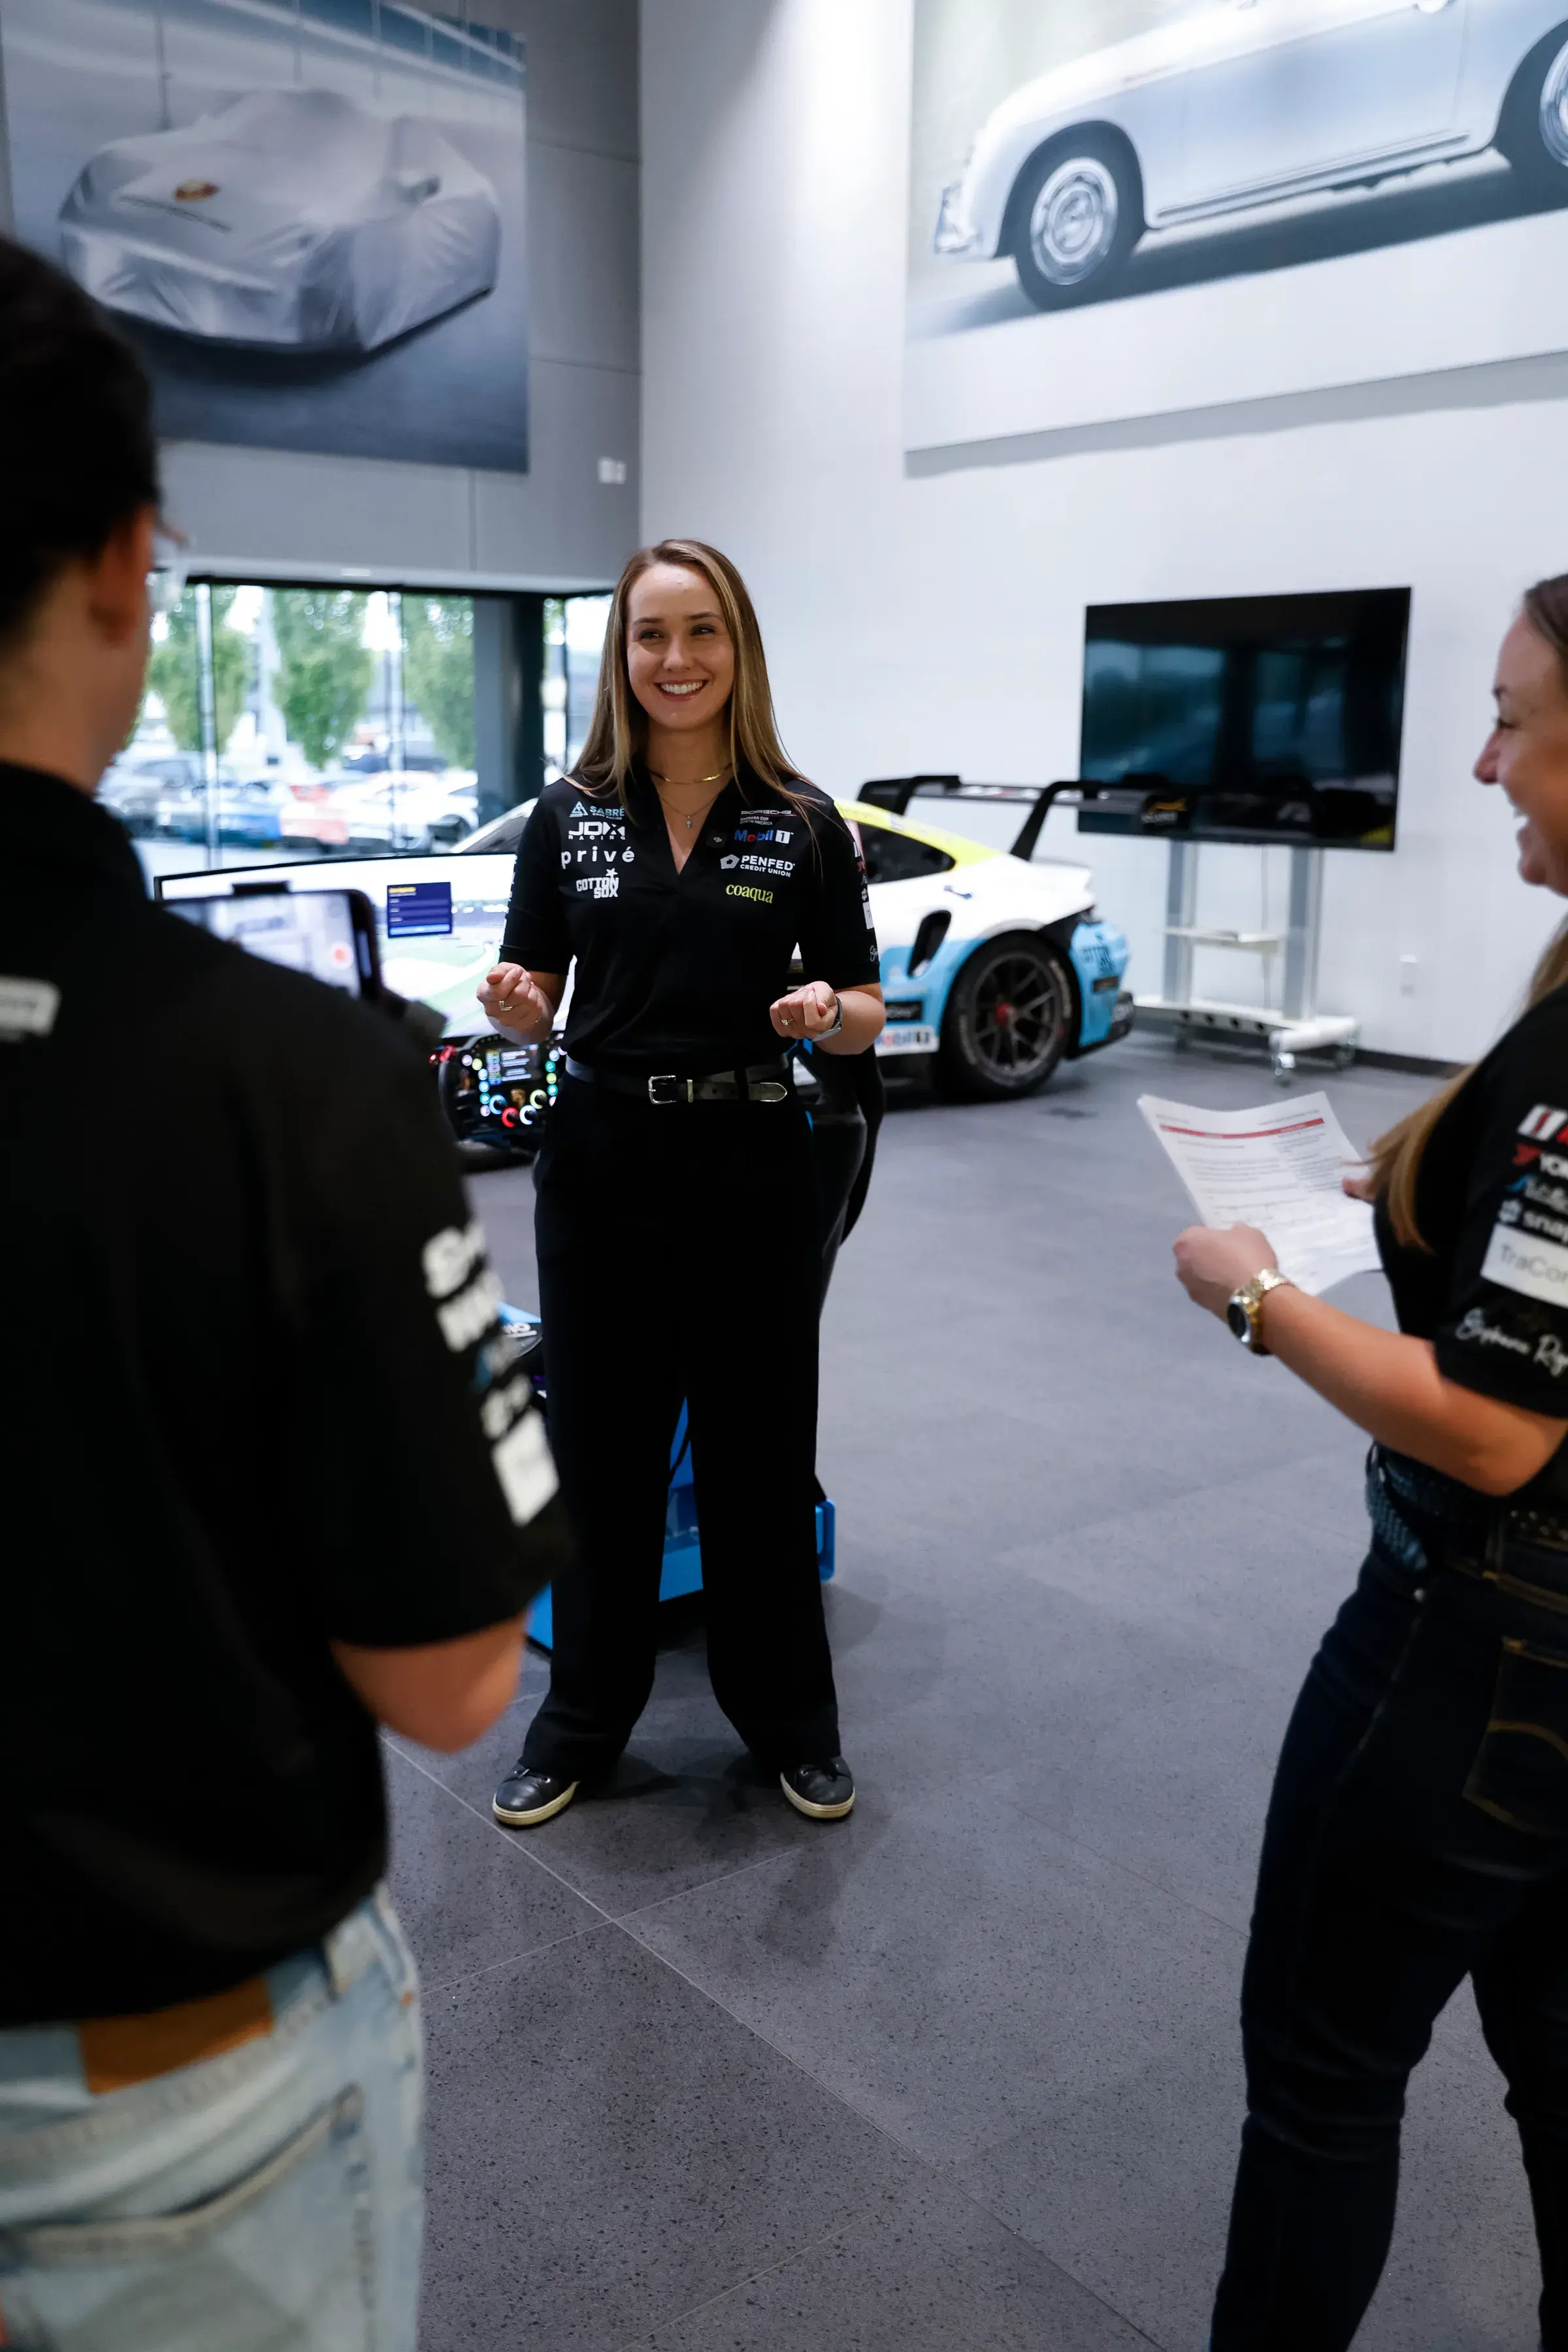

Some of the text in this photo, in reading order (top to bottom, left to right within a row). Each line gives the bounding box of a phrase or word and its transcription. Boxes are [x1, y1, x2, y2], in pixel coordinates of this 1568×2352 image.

[734, 829, 774, 842] Mobil
[561, 846, 634, 870] privé
[742, 855, 794, 871] PENFED
[740, 864, 791, 877] CREDIT UNION
[576, 877, 619, 892] COTTON
[594, 887, 618, 899] SOX
[726, 884, 774, 904] coaqua
